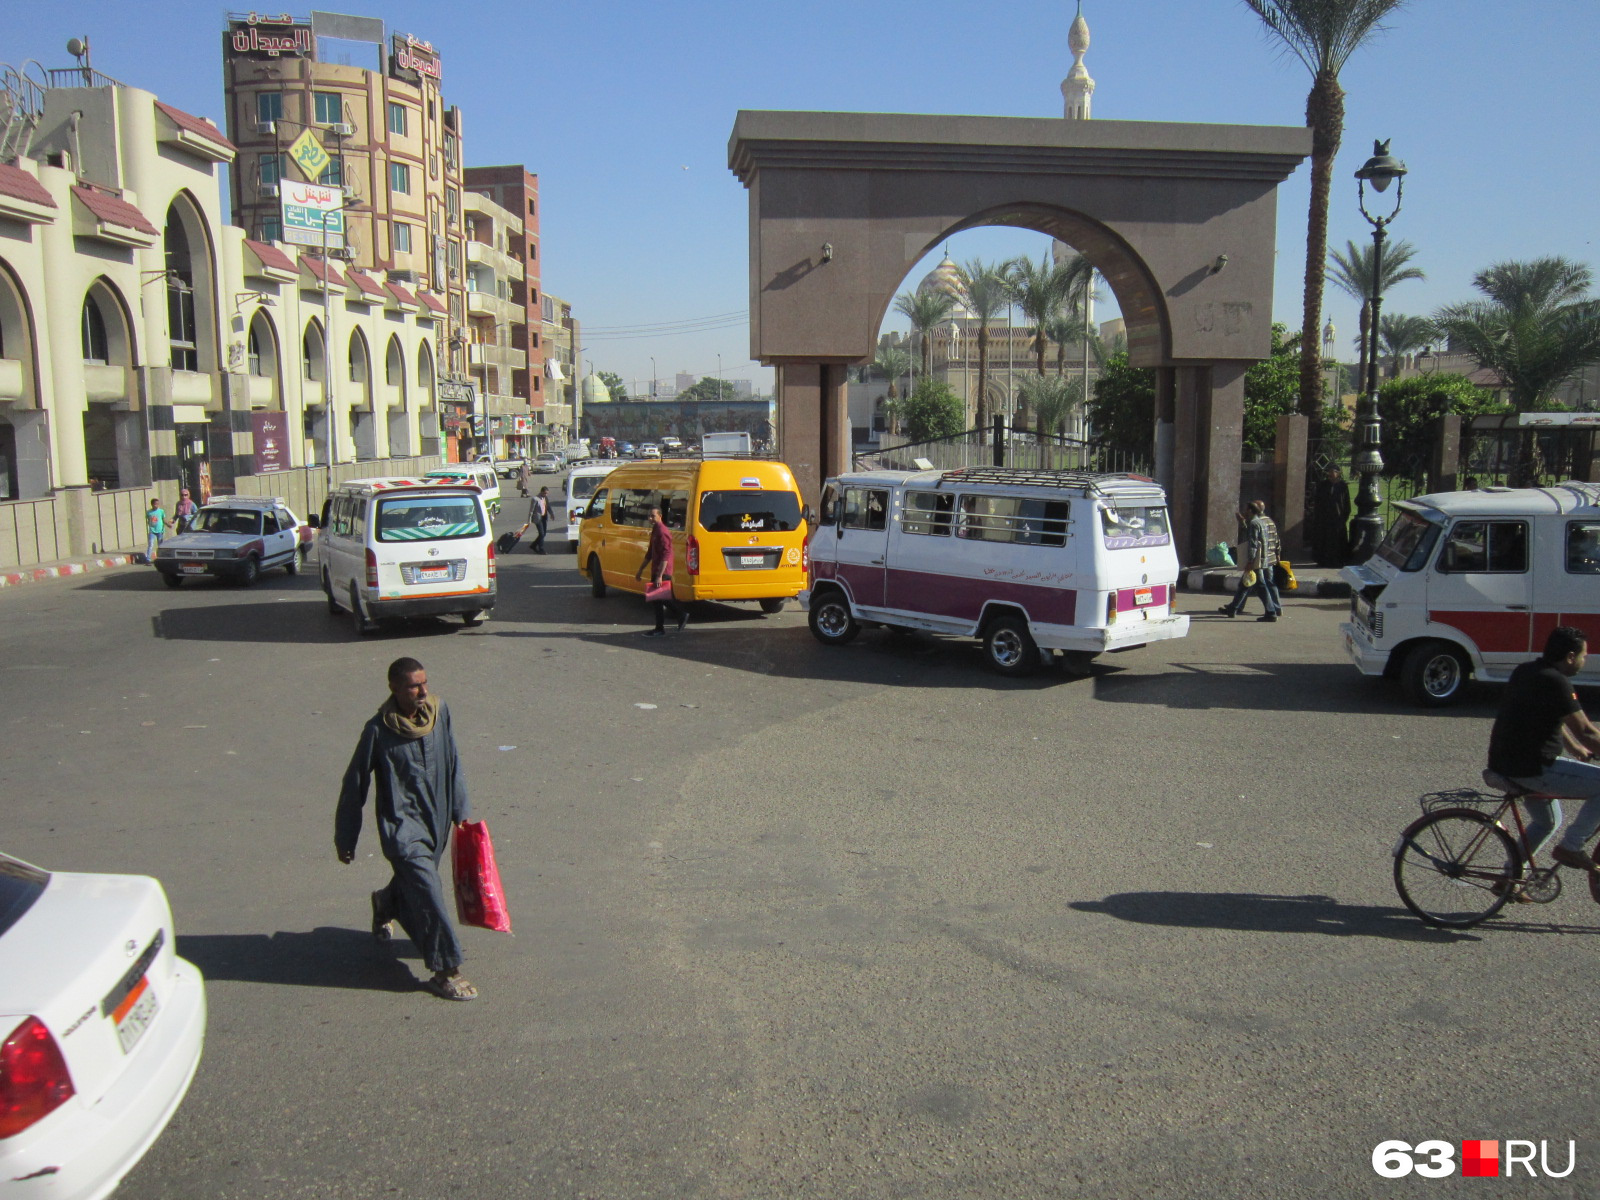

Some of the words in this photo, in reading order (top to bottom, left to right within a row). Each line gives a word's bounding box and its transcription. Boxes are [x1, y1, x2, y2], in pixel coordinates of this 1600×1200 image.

[247, 11, 293, 25] فندق
[233, 28, 310, 56] الميدان
[407, 33, 433, 53] فندق
[398, 47, 442, 79] الميدان
[294, 134, 325, 178] مطعم
[287, 208, 338, 226] كباب
